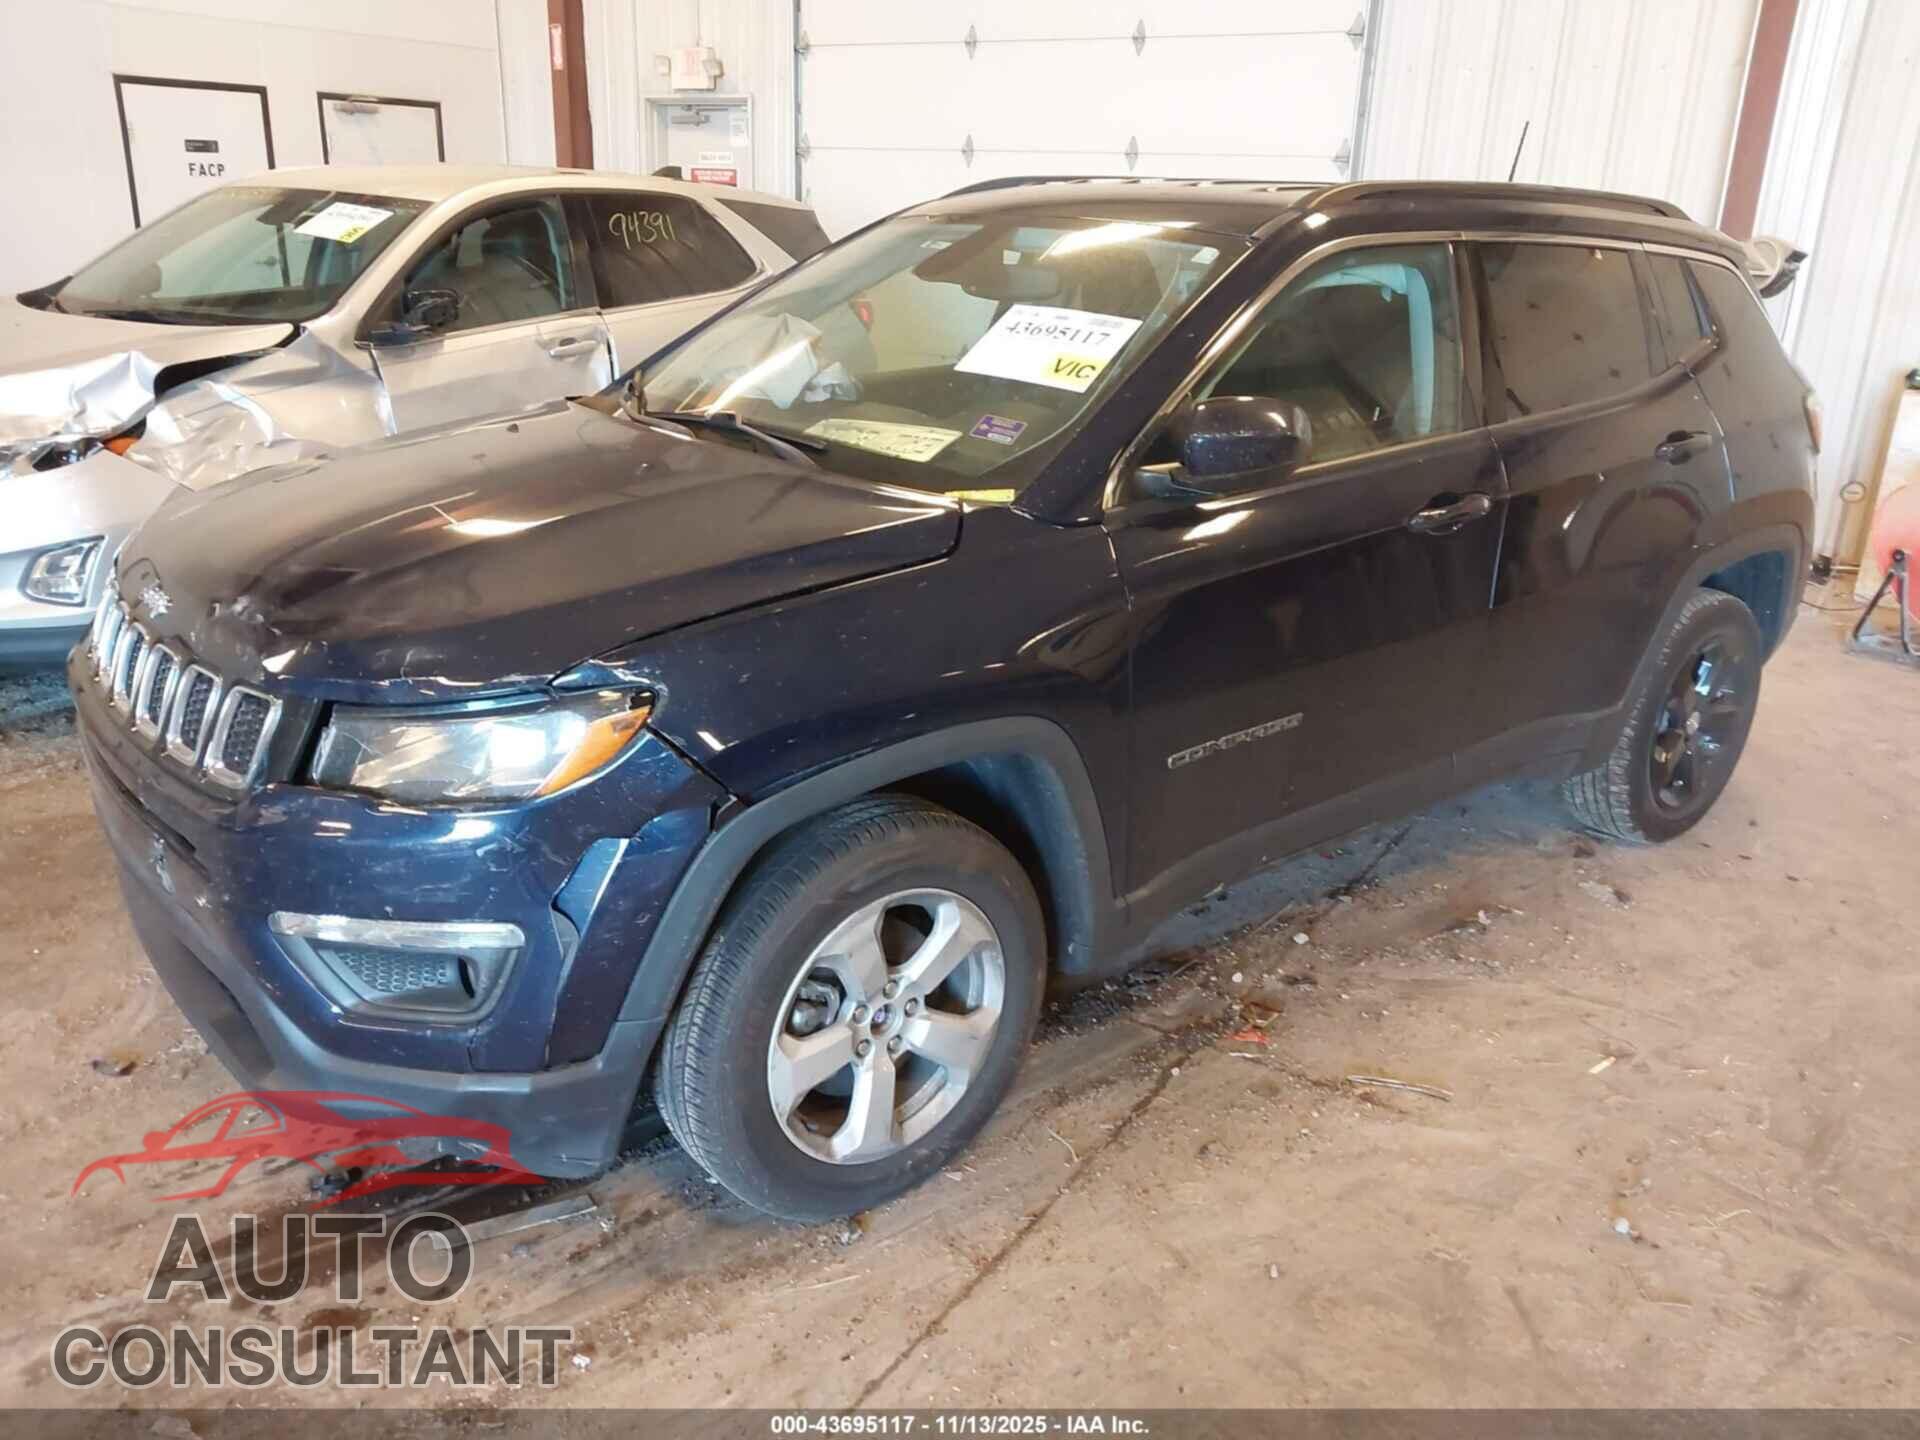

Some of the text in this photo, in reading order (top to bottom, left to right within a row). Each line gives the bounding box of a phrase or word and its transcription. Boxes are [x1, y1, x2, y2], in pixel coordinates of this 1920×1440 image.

[188, 162, 225, 177] FACP
[608, 211, 677, 249] 94391
[1005, 321, 1112, 345] 43695117
[1054, 358, 1097, 379] VIC
